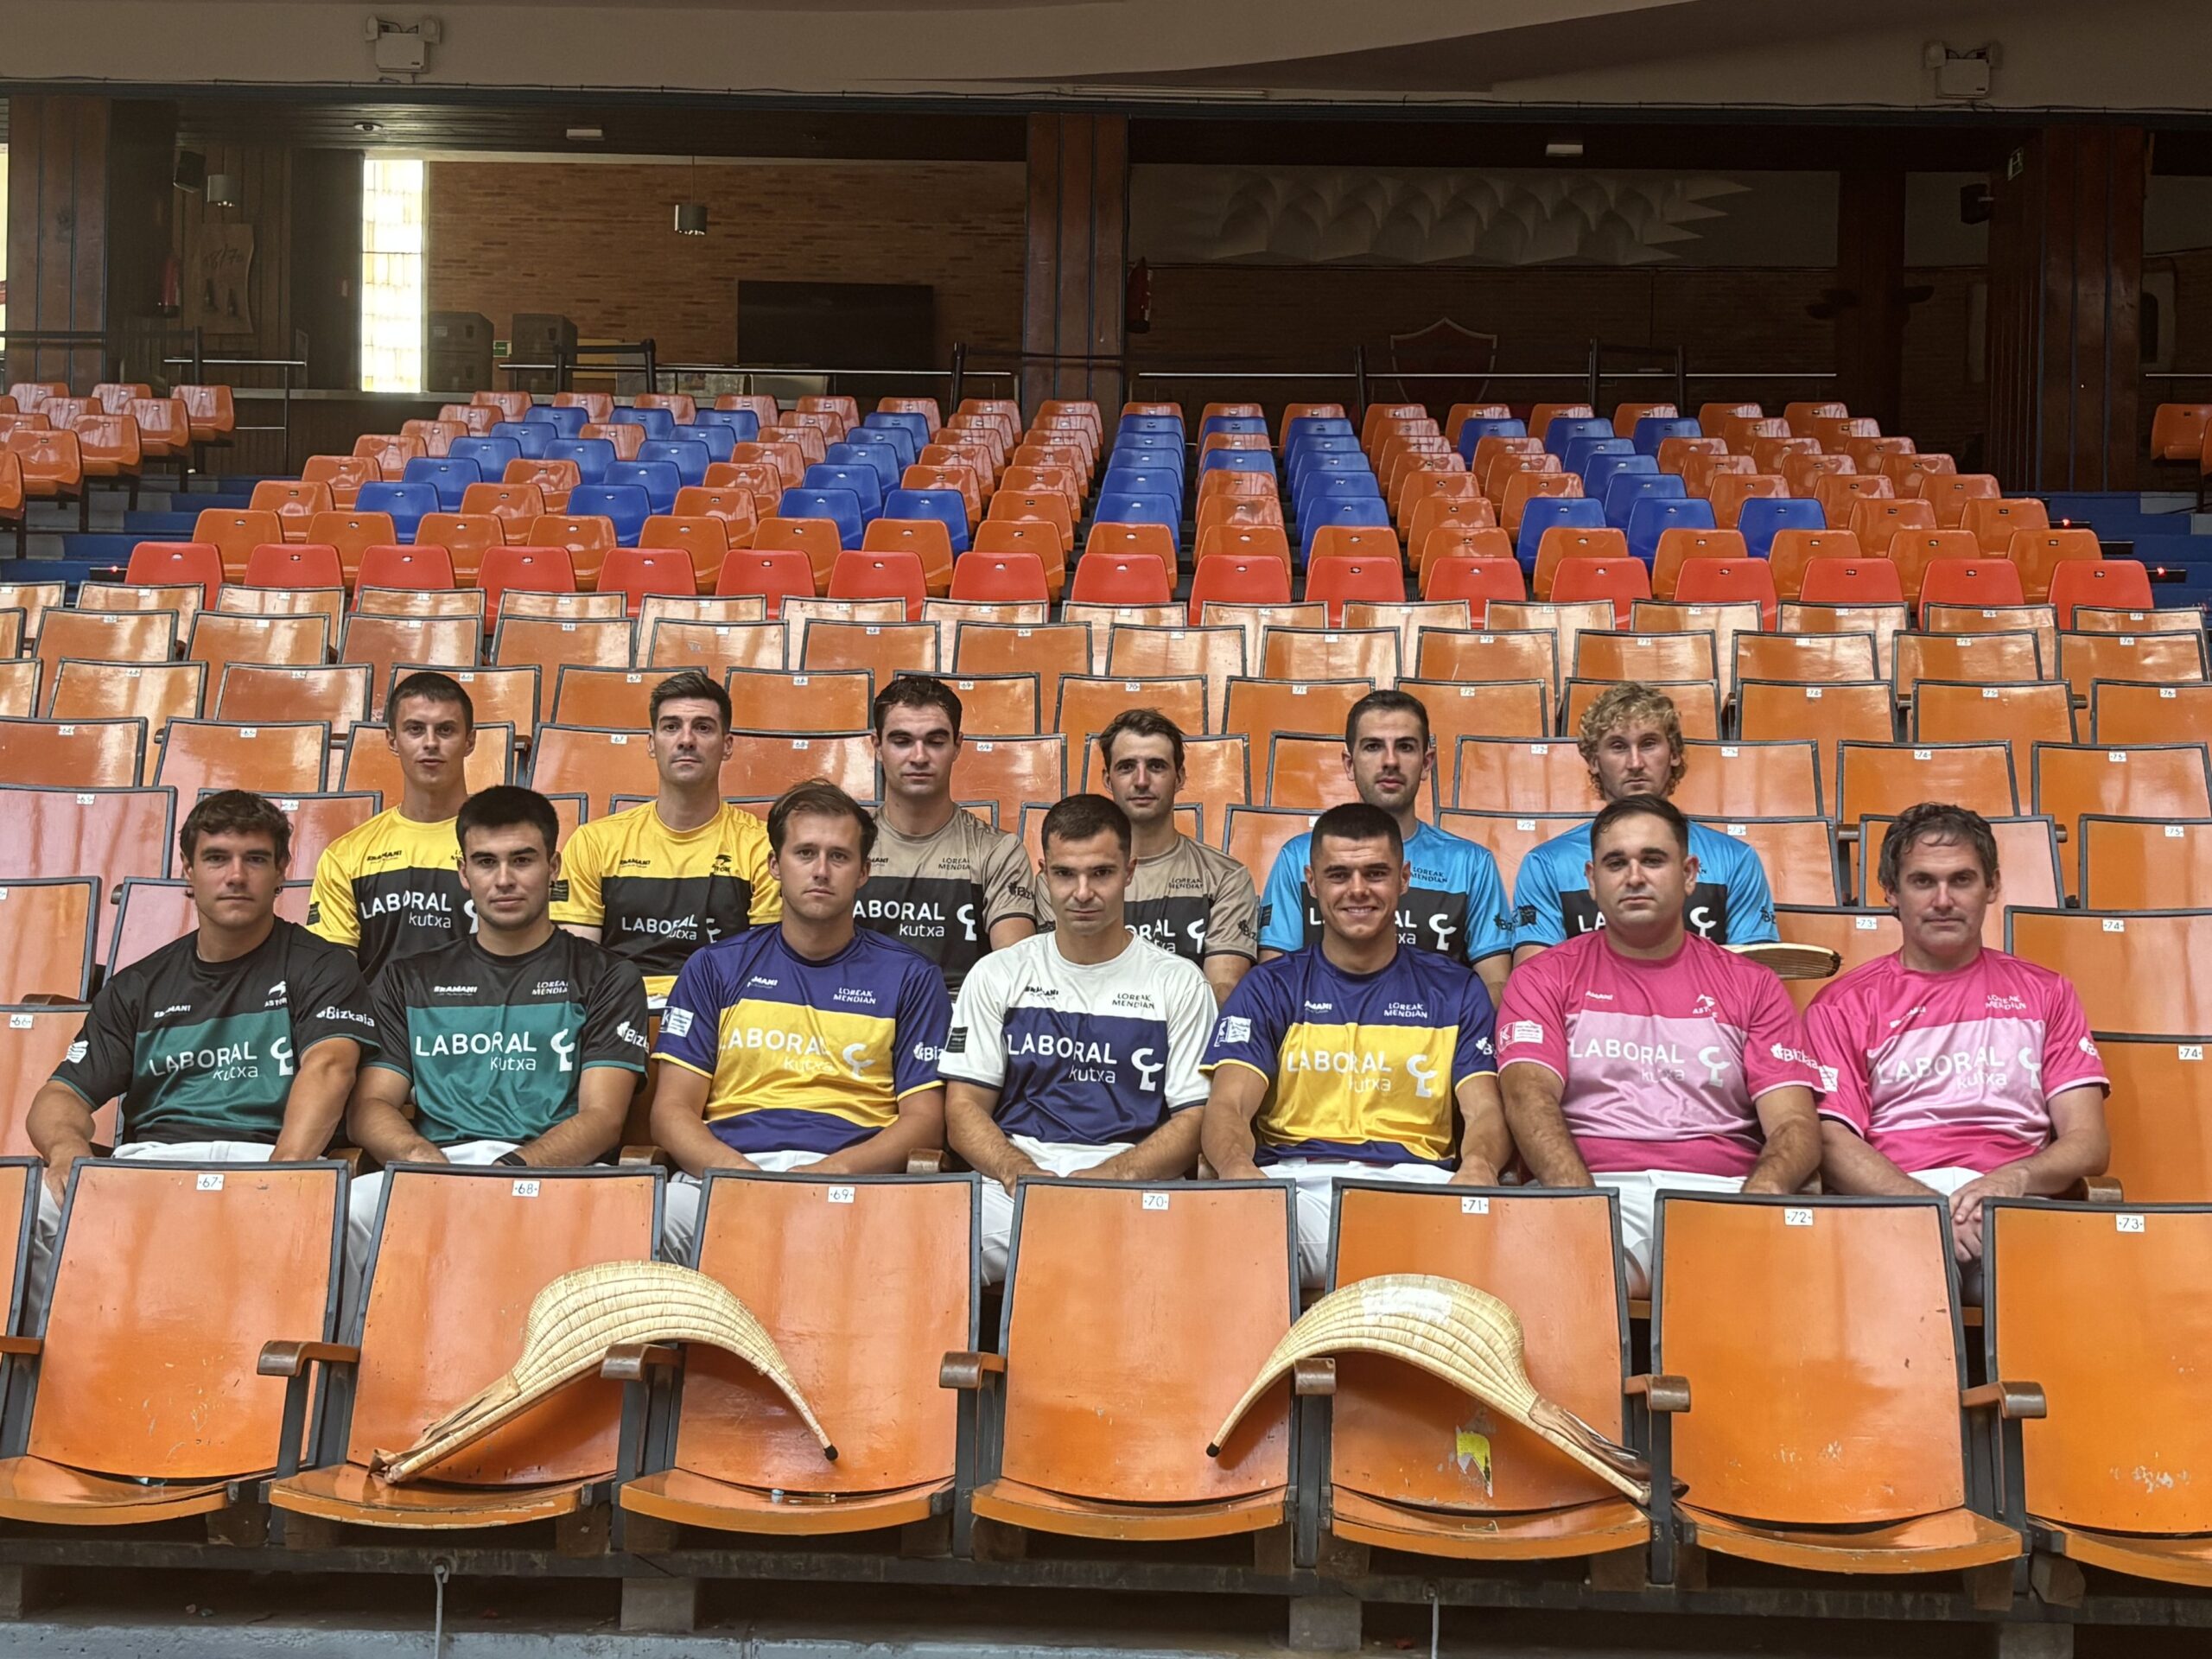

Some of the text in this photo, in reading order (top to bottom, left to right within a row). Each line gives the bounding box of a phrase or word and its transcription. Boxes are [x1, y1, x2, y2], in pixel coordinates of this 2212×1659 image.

[408, 912, 452, 929] kutxa
[899, 923, 945, 938] kutxa
[833, 994, 876, 1005] MENDIAN
[838, 987, 874, 997] LOREAK
[1117, 993, 1151, 1002] LOREAK
[1112, 999, 1155, 1010] MENDIAN
[1389, 1001, 1424, 1011] LOREAK
[326, 1006, 375, 1027] Bizkaia
[1383, 1009, 1427, 1019] MENDIAN
[416, 1031, 537, 1057] LABORAL
[1007, 1033, 1117, 1065] LABORAL
[1570, 1039, 1685, 1065] LABORAL
[149, 1042, 257, 1077] LABORAL
[490, 1056, 537, 1071] kutxa
[1877, 1046, 2005, 1084] LABORAL
[1069, 1065, 1116, 1084] kutxa
